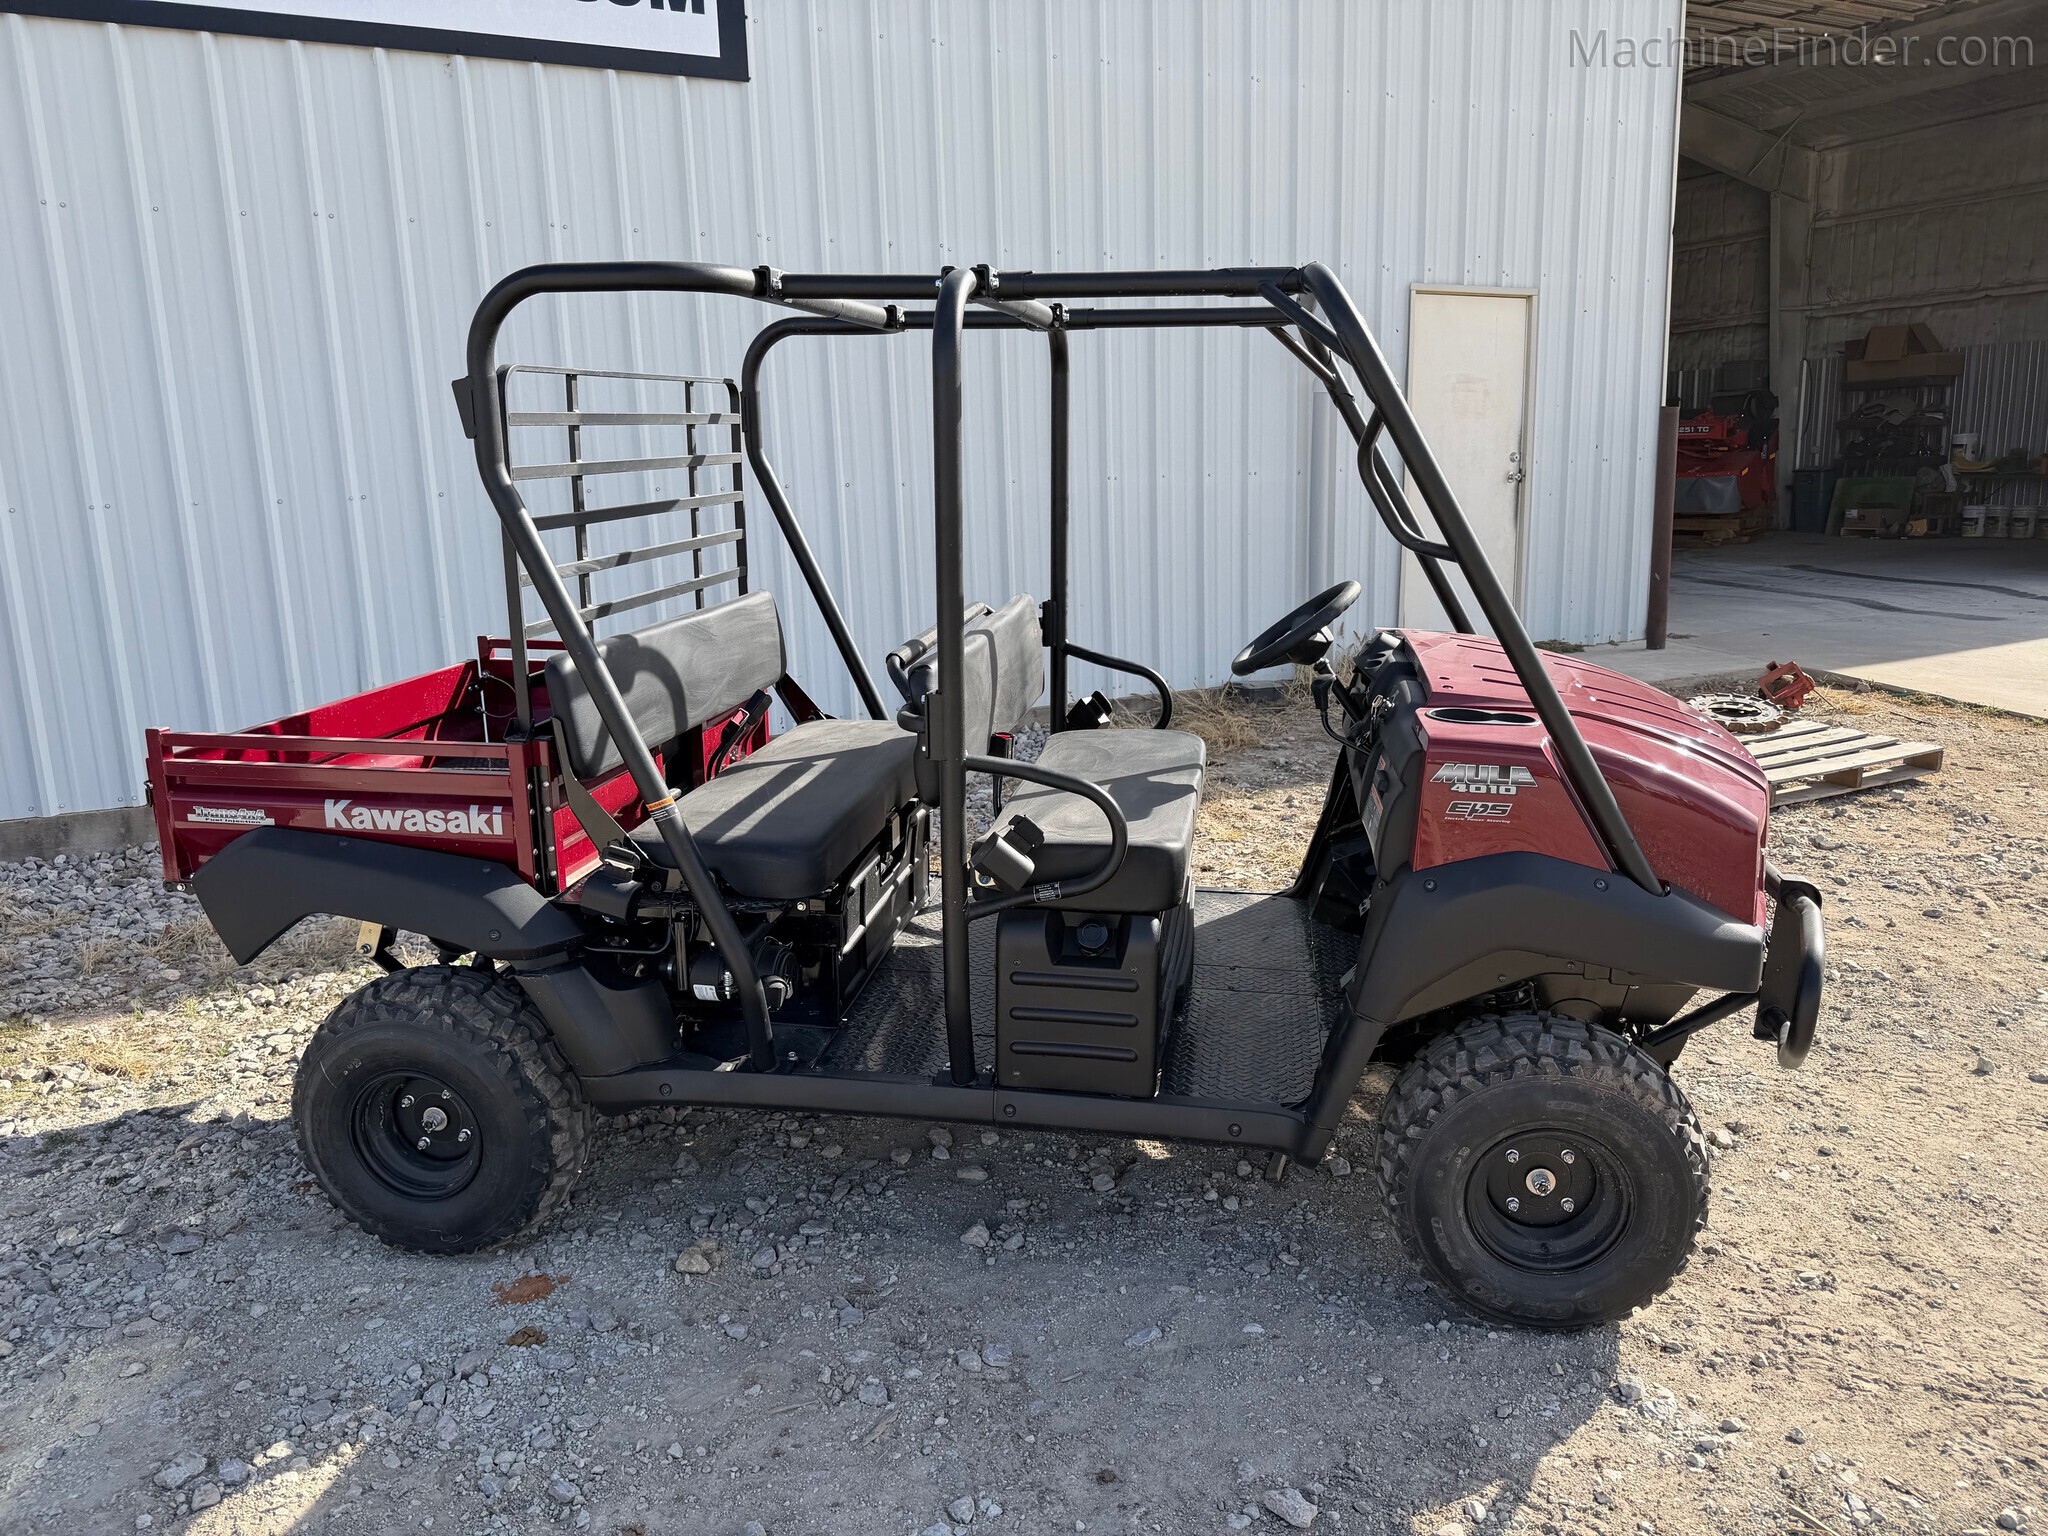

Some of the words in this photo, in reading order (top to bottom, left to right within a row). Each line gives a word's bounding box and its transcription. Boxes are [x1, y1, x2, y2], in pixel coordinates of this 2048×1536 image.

[1430, 764, 1538, 787] MULE
[1451, 783, 1517, 795] 4010
[324, 799, 503, 835] Kawasaki
